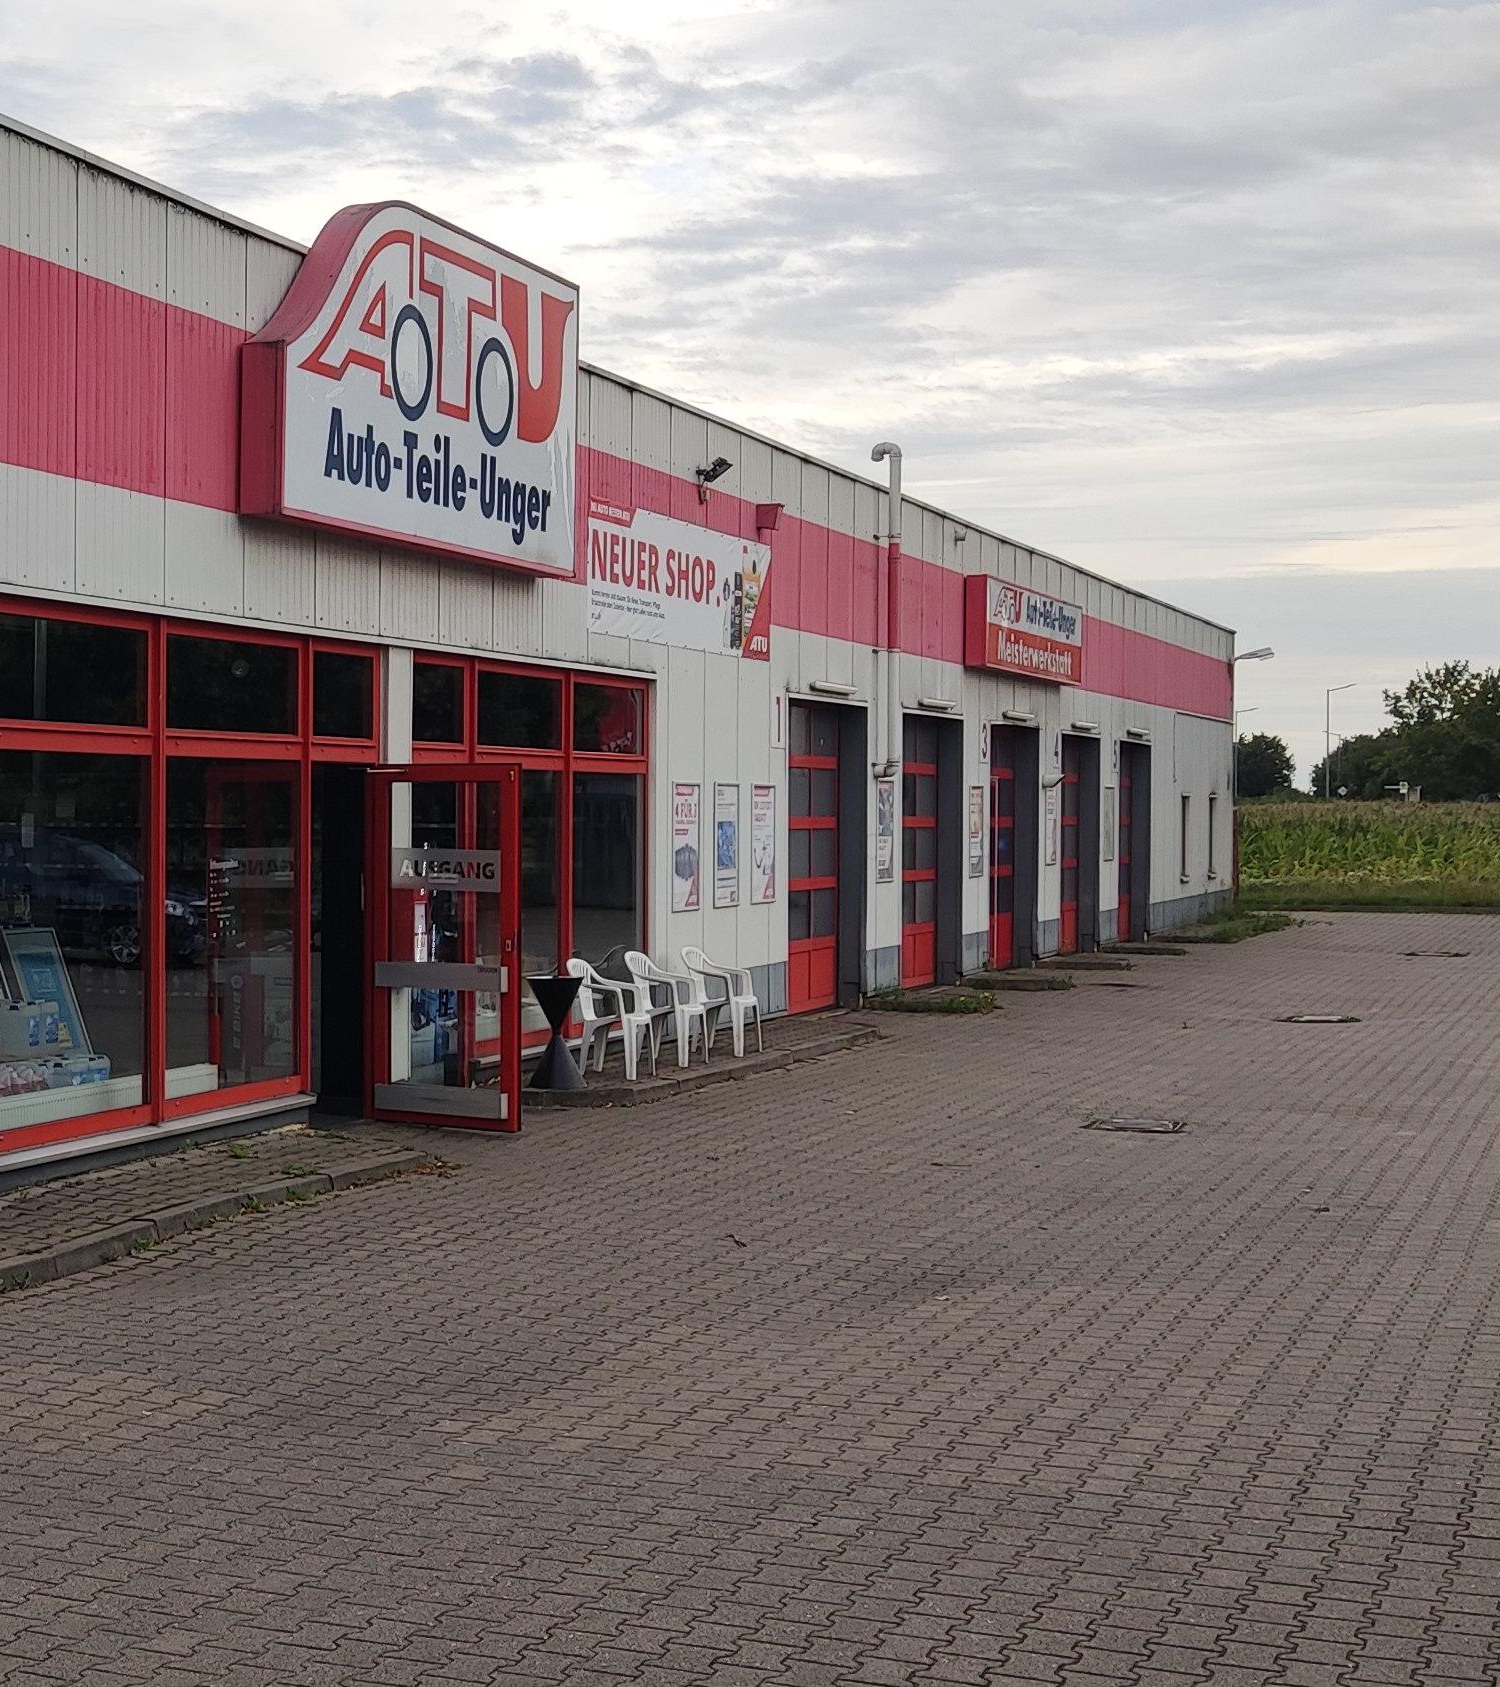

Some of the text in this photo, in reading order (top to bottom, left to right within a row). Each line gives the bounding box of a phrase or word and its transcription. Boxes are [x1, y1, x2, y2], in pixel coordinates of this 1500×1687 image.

[297, 228, 575, 446] ATU
[324, 408, 551, 545] Auto-Teile-Unger
[592, 529, 721, 608] NEUER SHOP.
[749, 635, 768, 653] ATU
[997, 630, 1071, 676] Meisterwerkstatt
[400, 859, 495, 881] AUSGANG
